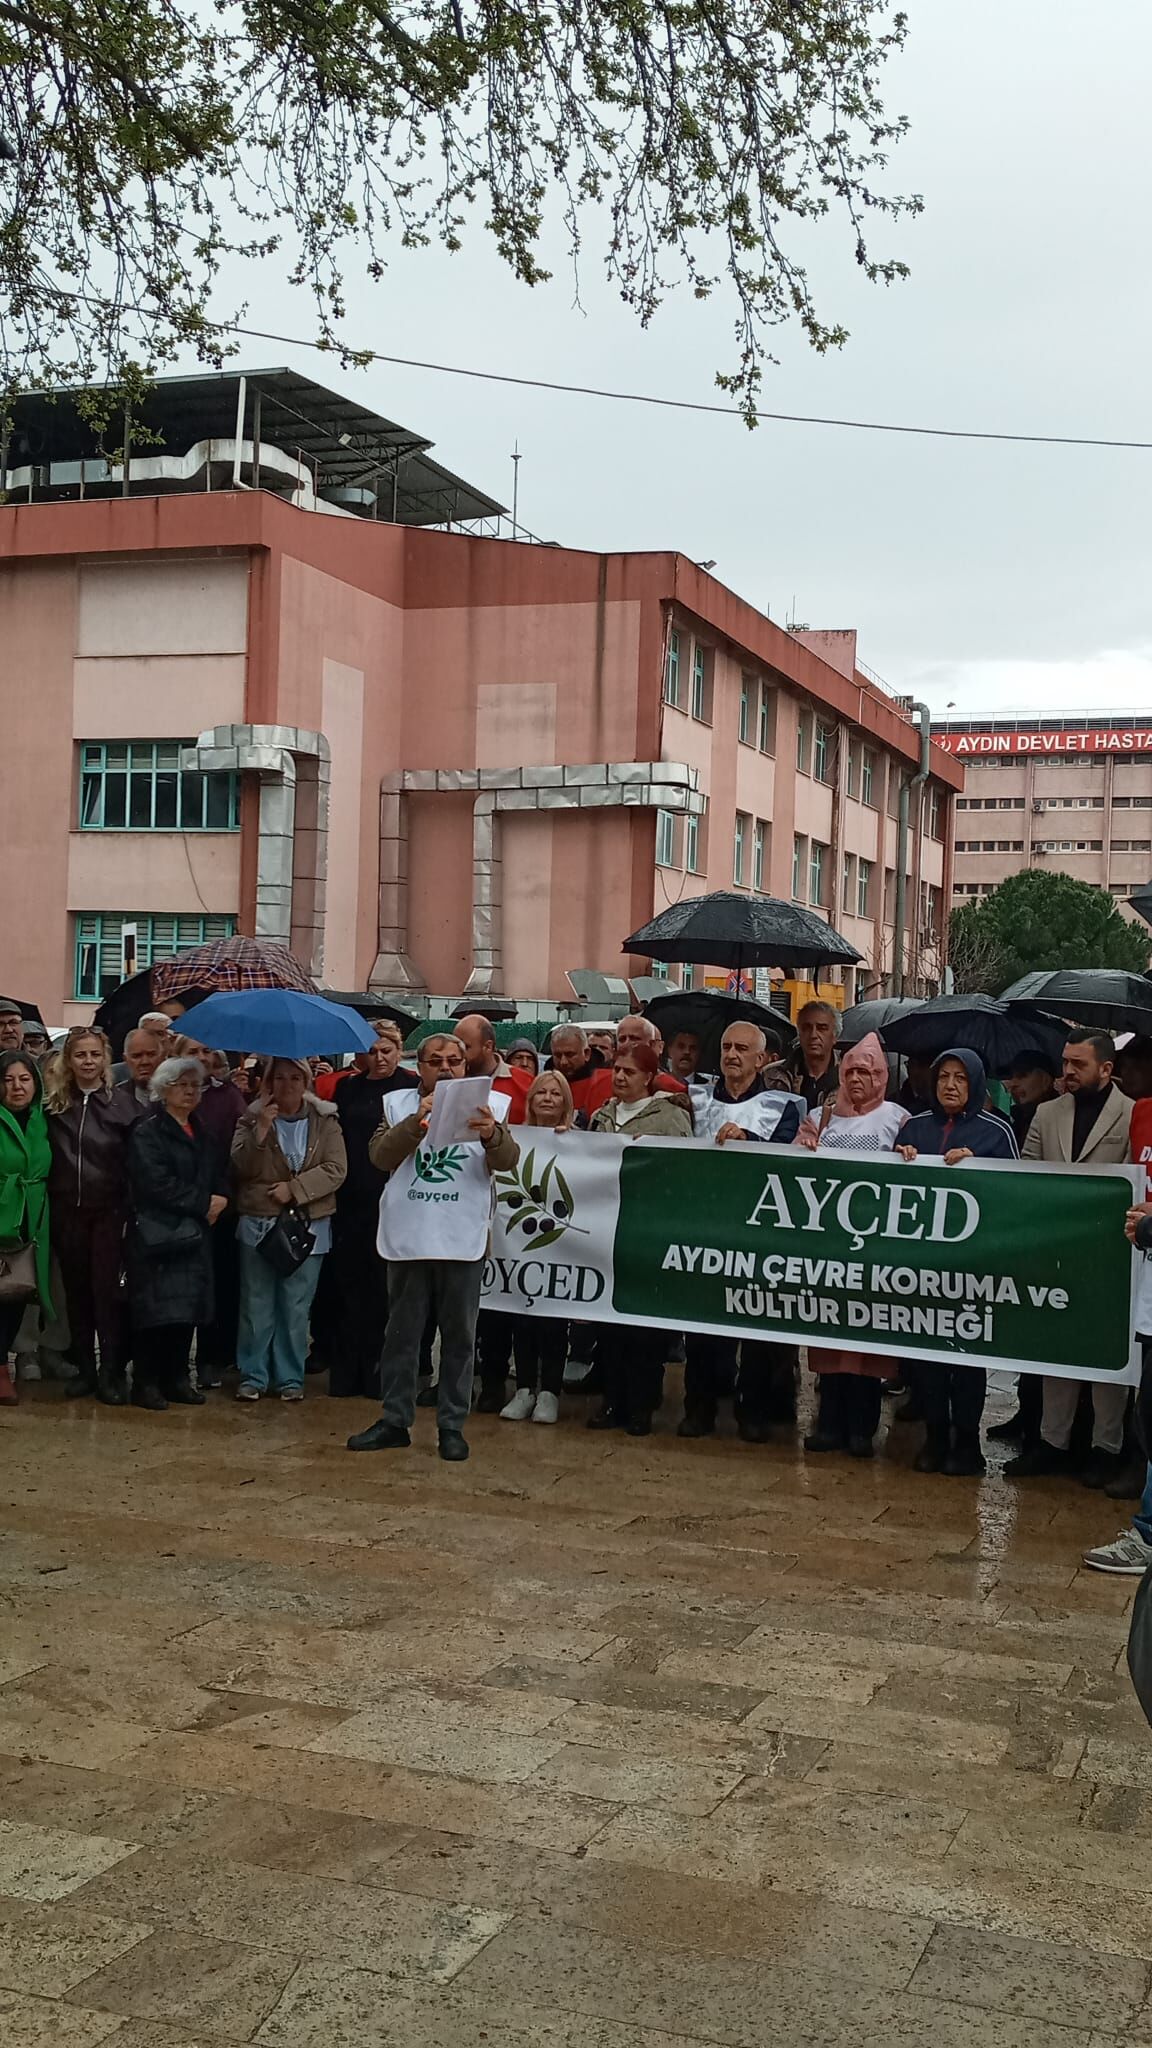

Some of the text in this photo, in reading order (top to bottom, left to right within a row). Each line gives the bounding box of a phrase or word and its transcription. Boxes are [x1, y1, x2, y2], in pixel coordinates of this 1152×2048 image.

[956, 736, 1010, 752] AYDIN
[1017, 734, 1090, 751] DEVLET
[408, 1189, 459, 1202] @ayçed
[746, 1173, 980, 1251] AYÇED
[661, 1244, 1069, 1309] AYDIN ÇEVRE KORUMA ve
[725, 1283, 993, 1342] KÜLTÜR DERNEĞİ
